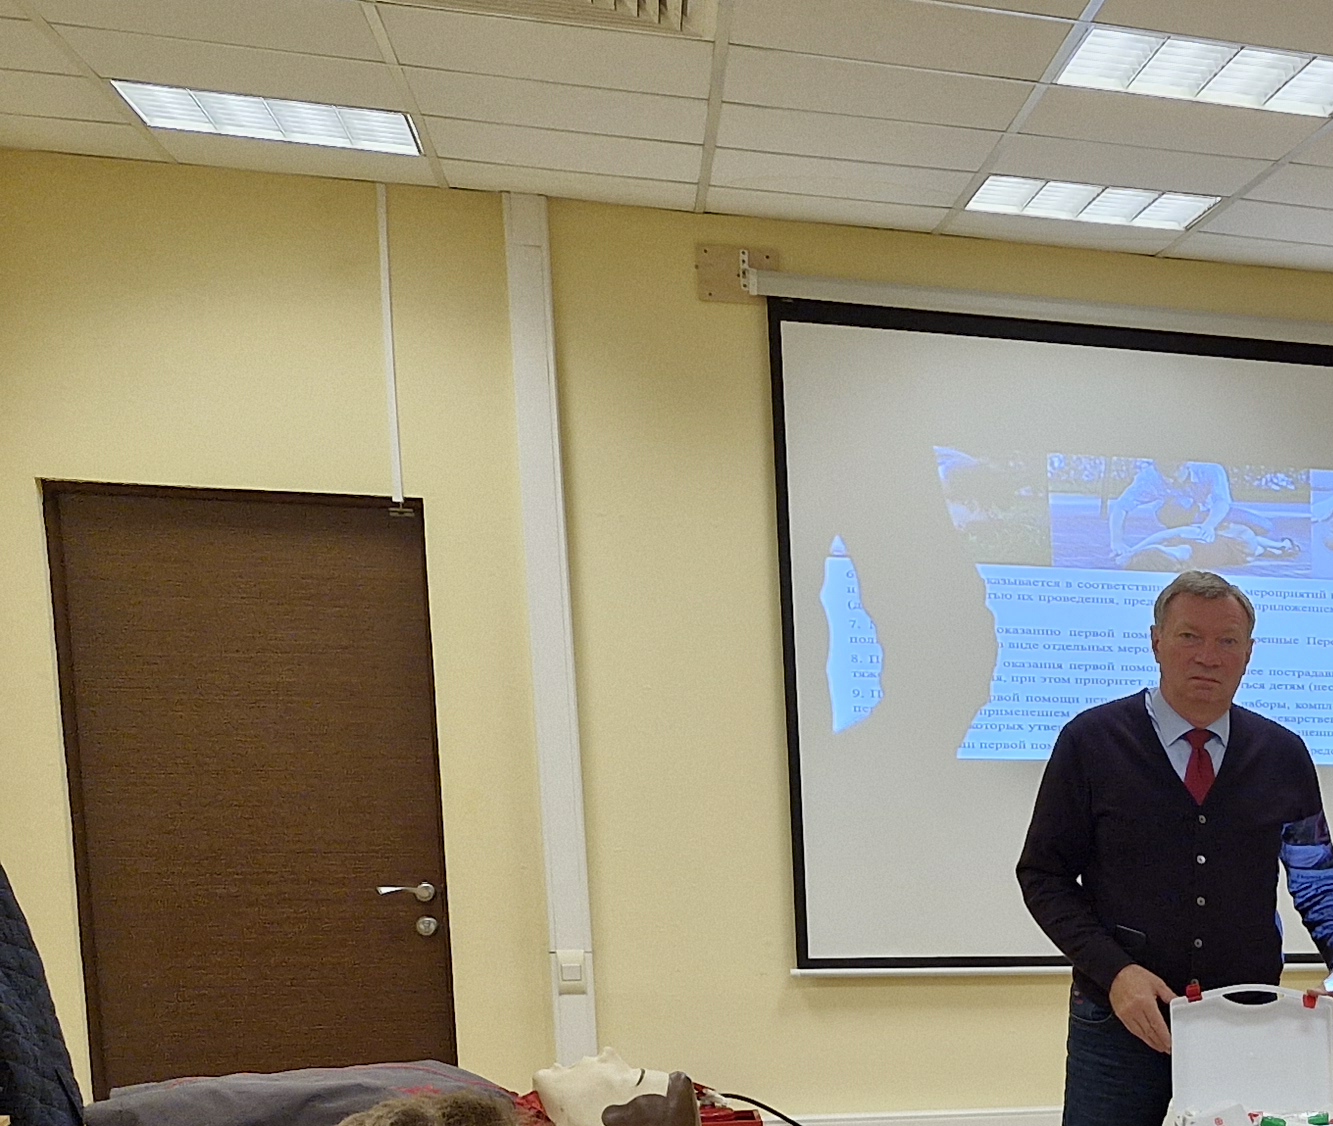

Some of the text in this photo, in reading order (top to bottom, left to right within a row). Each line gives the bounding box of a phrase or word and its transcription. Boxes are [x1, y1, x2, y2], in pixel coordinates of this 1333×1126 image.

[986, 577, 1060, 588] казывается
[1069, 627, 1115, 640] первой
[1043, 642, 1113, 653] отдельных
[1069, 661, 1115, 674] первой
[1269, 683, 1305, 691] детям
[1025, 694, 1080, 705] помощи
